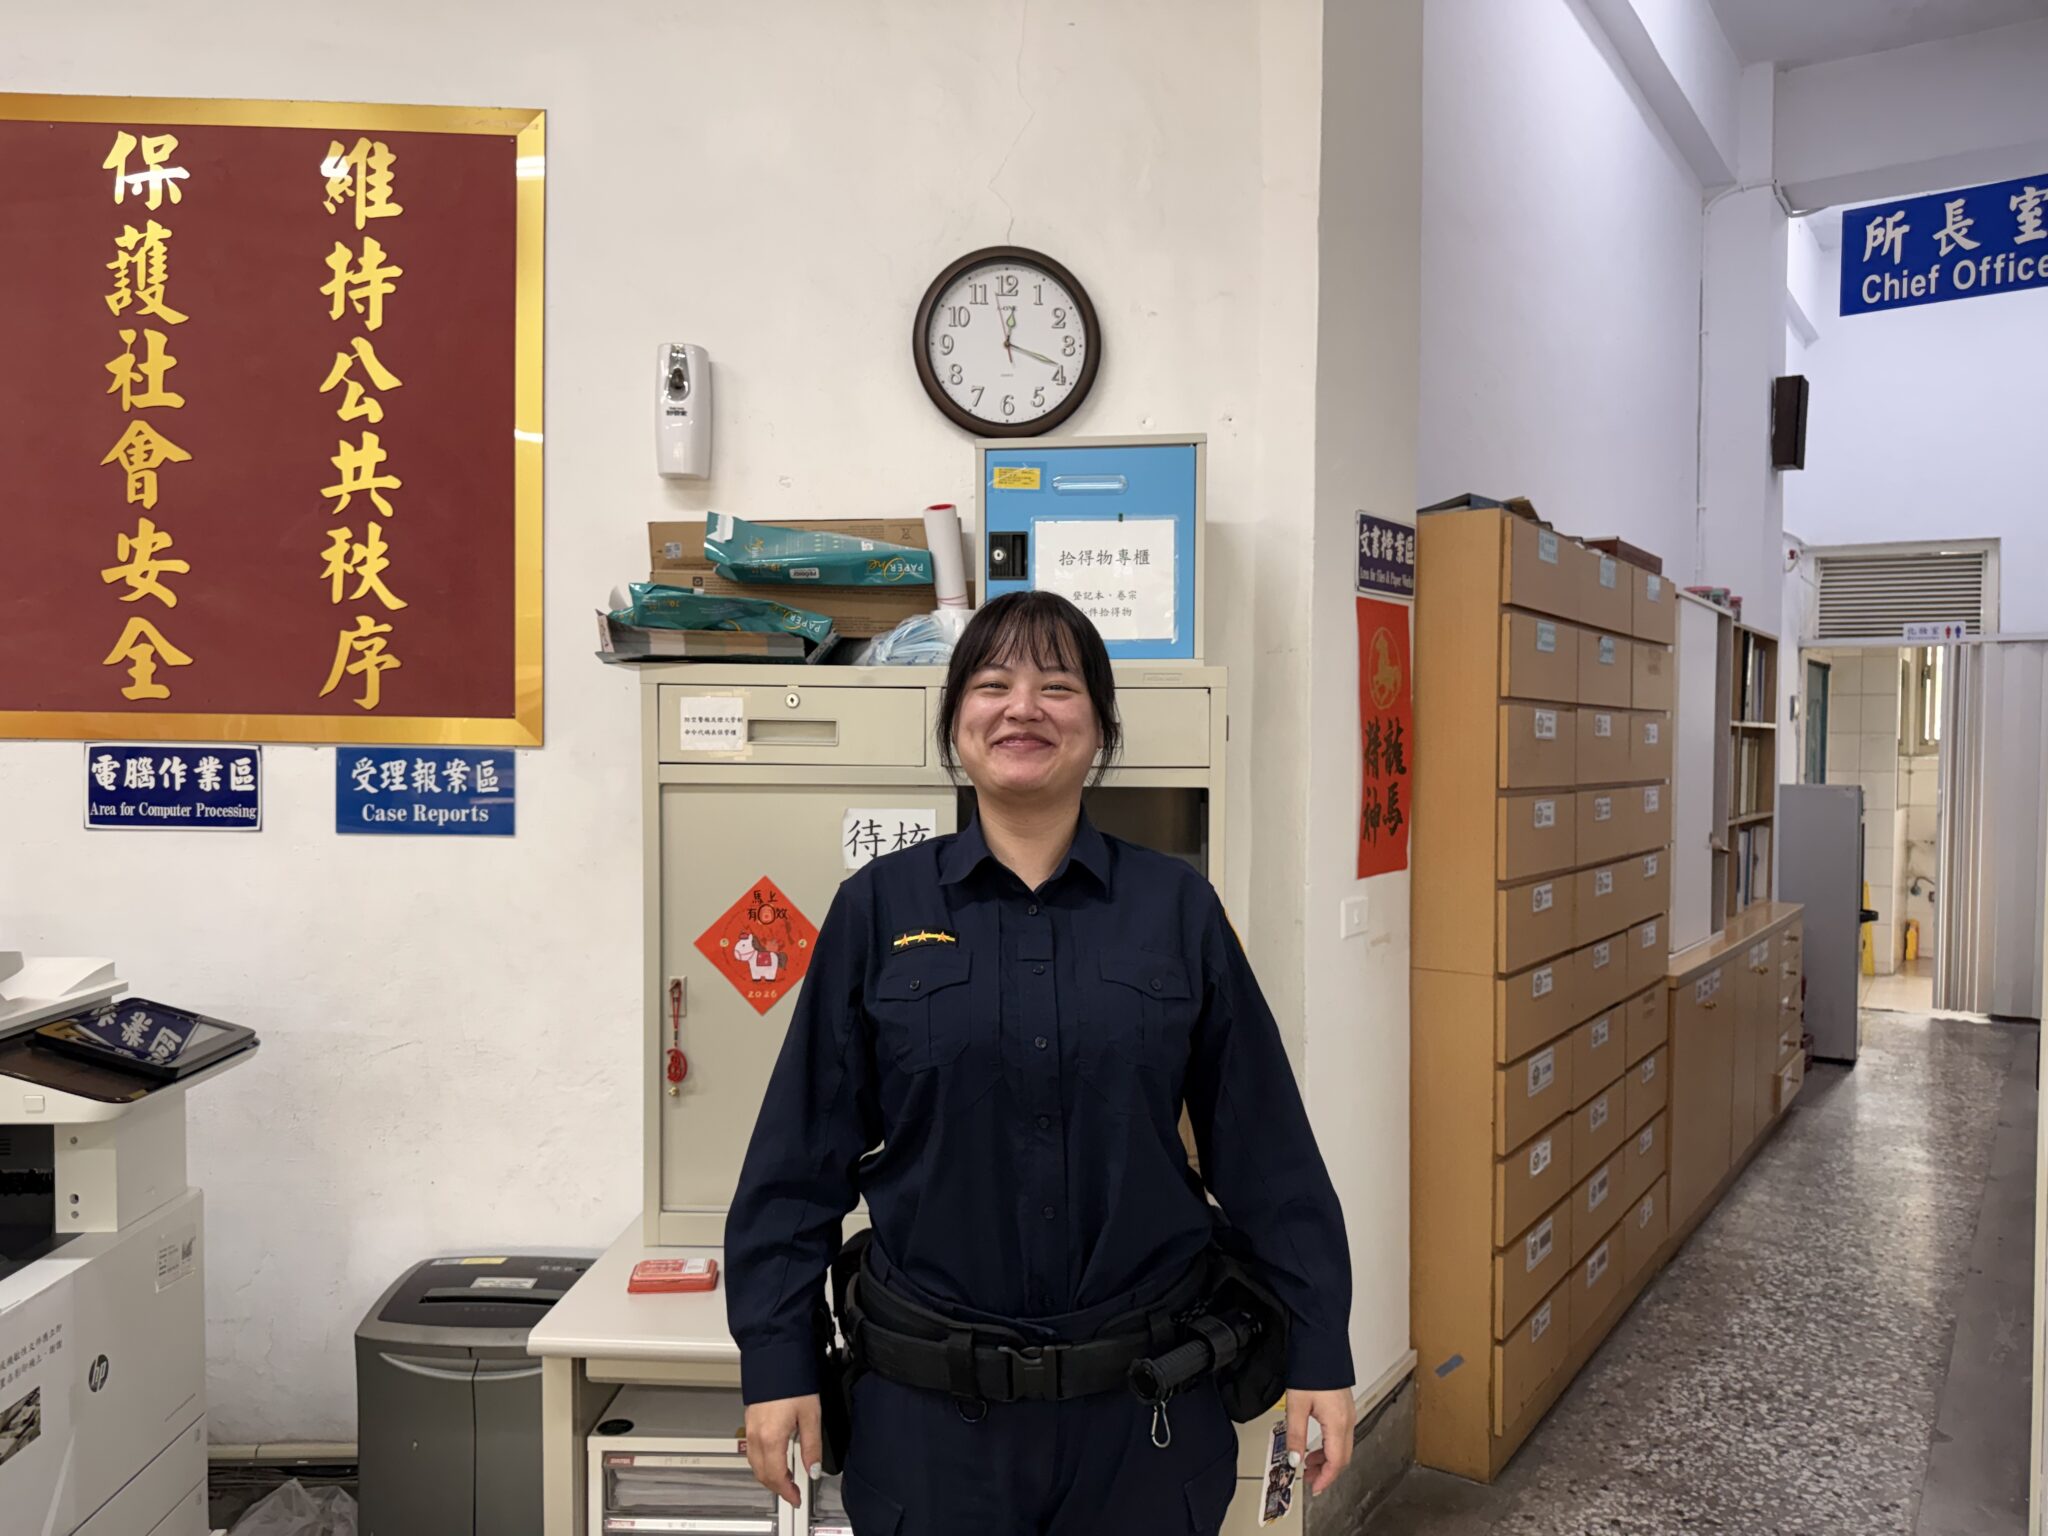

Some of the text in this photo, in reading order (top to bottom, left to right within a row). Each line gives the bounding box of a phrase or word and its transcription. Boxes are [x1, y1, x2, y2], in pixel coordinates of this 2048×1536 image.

[1863, 186, 2048, 265] 所長室
[969, 284, 989, 305] 11
[995, 275, 1019, 297] 12
[1033, 284, 1044, 306] 1
[1862, 264, 1940, 304] Chief
[949, 306, 971, 328] 10
[1052, 308, 1067, 329] 2
[941, 334, 954, 356] 9
[1062, 335, 1076, 357] 3
[950, 364, 963, 386] 8
[1052, 365, 1067, 386] 4
[971, 386, 985, 408] 7
[1003, 394, 1015, 416] 6
[1031, 386, 1045, 408] 5
[101, 131, 193, 700] 保護社會安全
[319, 137, 408, 710] 維持公共秩序
[889, 562, 924, 573] PAPER
[1059, 548, 1151, 566] 拾得物專櫃
[91, 754, 256, 792] 電腦作業區
[352, 757, 500, 794] 受理報案區
[1382, 717, 1407, 836] 龍馬
[90, 802, 258, 820] Area for Computer Processing
[362, 803, 490, 827] Case Reports
[753, 890, 778, 905] 馬上
[748, 990, 778, 999] 2026
